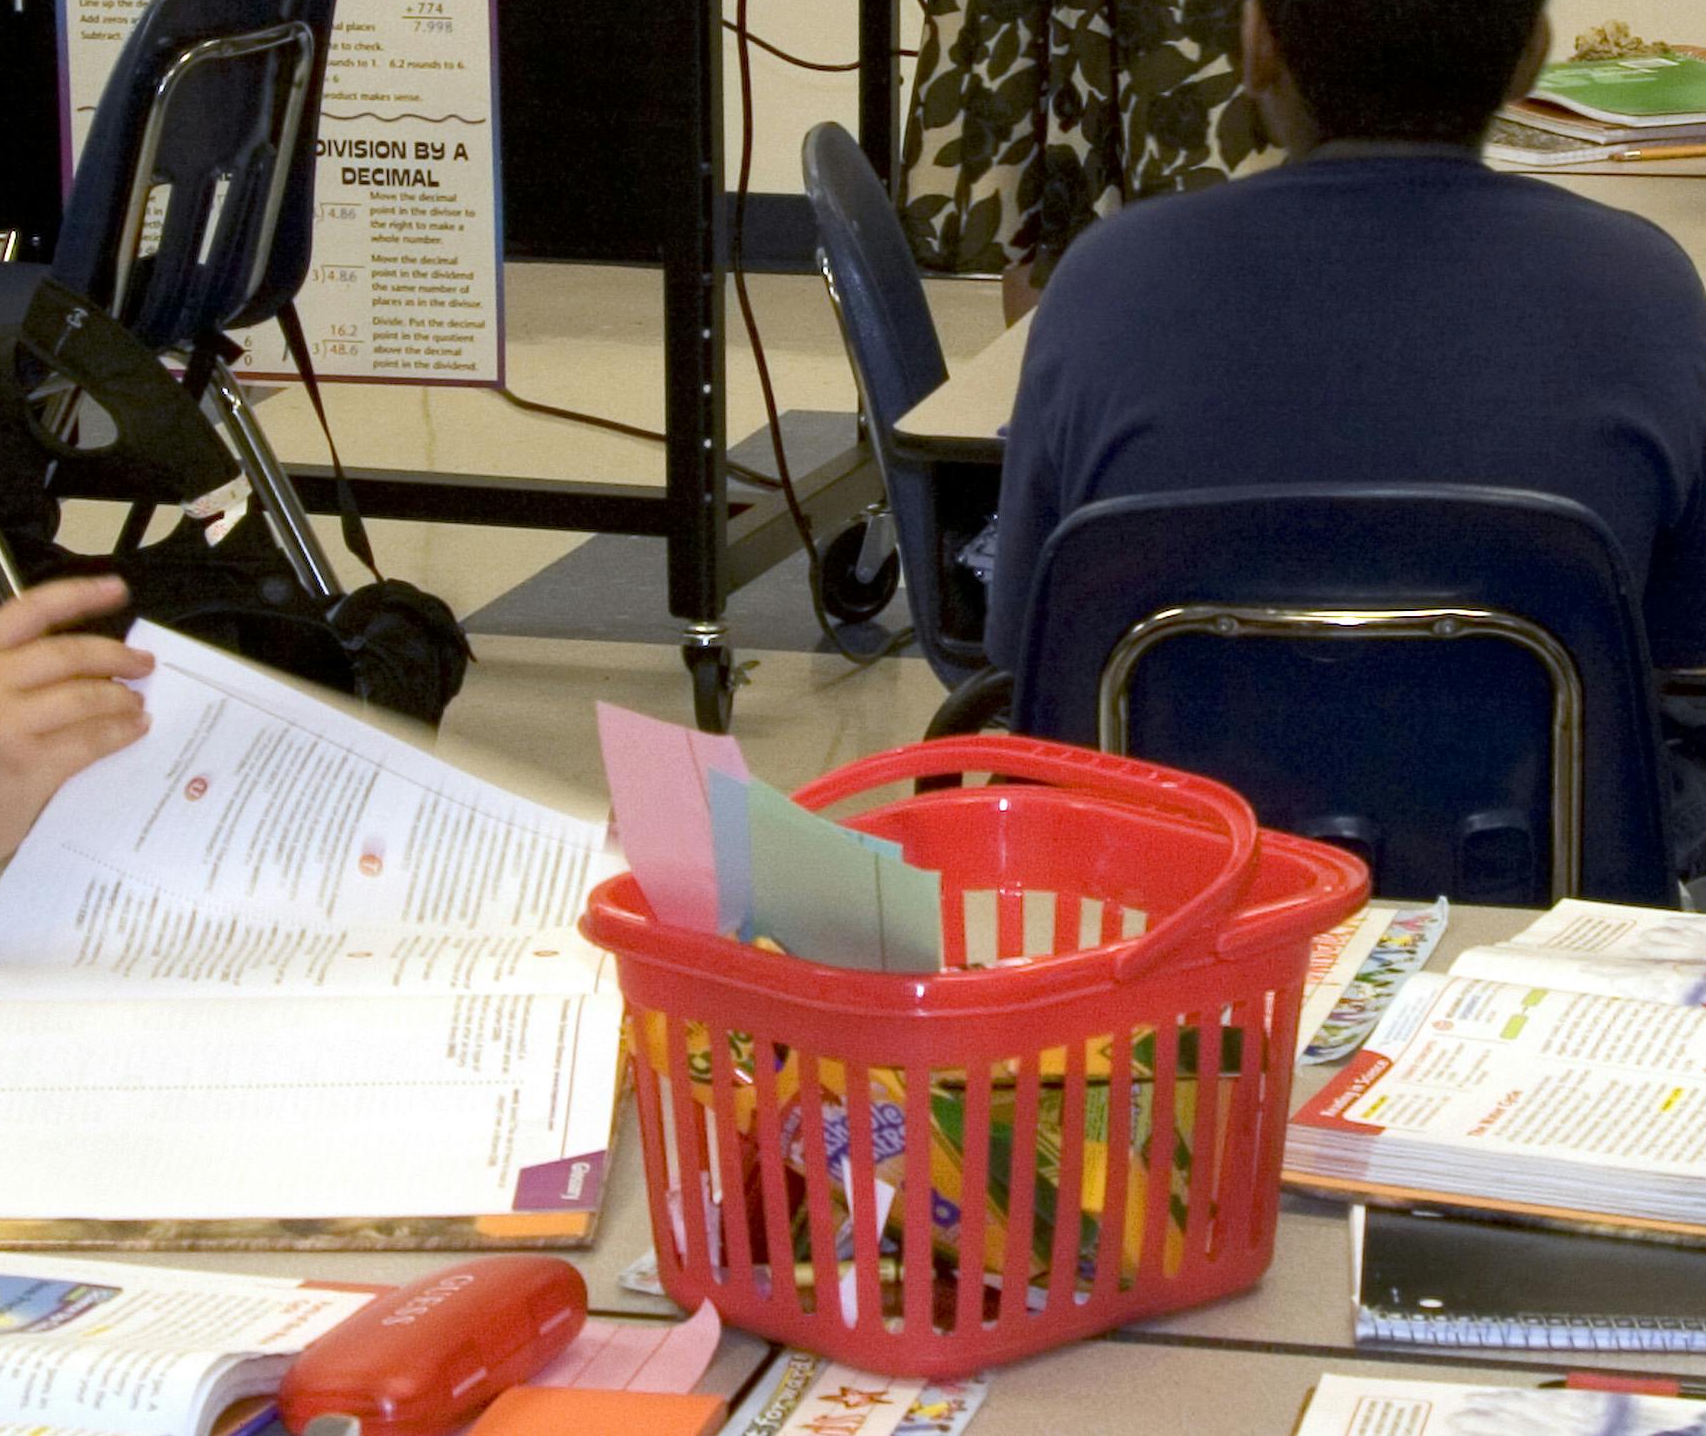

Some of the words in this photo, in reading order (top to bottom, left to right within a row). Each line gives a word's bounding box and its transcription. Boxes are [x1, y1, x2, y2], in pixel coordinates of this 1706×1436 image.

[413, 21, 453, 34] 7.998
[414, 141, 445, 161] BY
[453, 143, 469, 162] A
[341, 167, 440, 188] DECIMAL
[327, 208, 357, 220] 4.86
[327, 270, 358, 283] 4.86
[330, 324, 358, 336] 16.2
[329, 343, 358, 356] 48.6
[381, 1273, 475, 1326] GUESS
